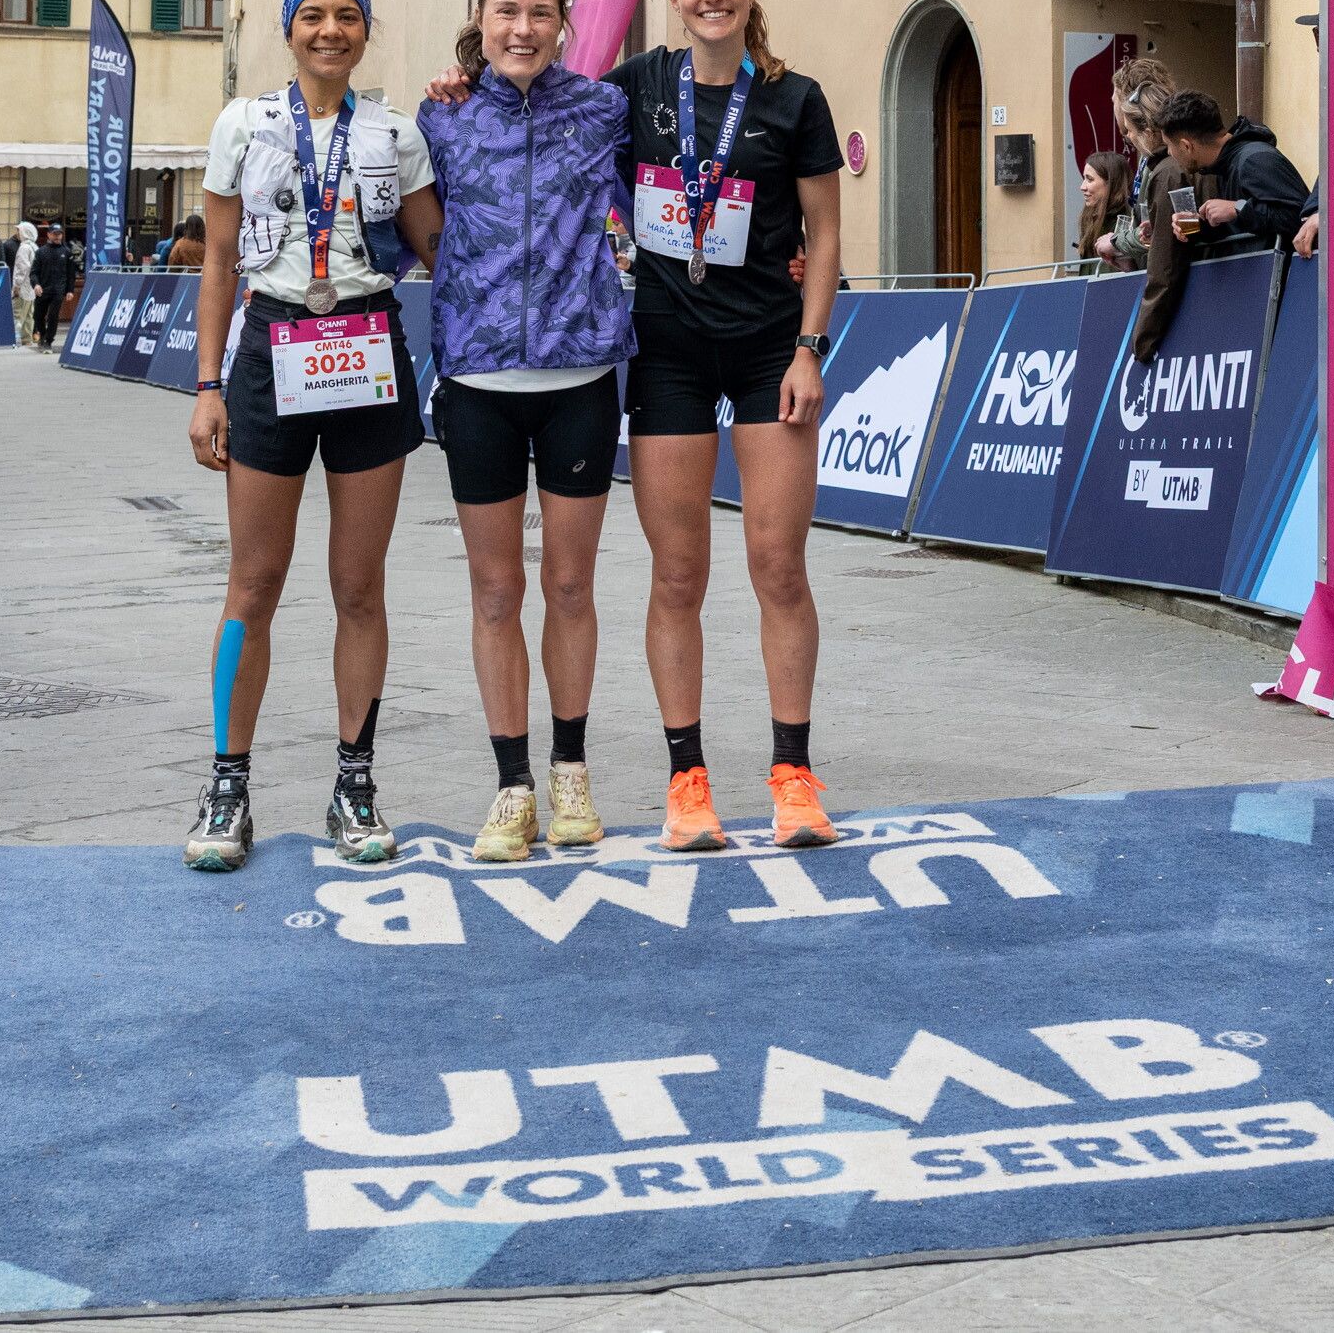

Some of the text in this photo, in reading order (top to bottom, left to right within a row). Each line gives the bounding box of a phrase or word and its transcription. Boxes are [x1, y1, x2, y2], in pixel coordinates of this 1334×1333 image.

[717, 106, 739, 156] FINISHER
[327, 135, 345, 182] FINISHER
[322, 188, 334, 212] CMT
[661, 203, 716, 230] 301
[167, 328, 197, 351] SUUNTO
[315, 340, 352, 352] CMT46
[304, 351, 366, 376] 3023
[305, 375, 369, 391] MARGHERITA
[1120, 350, 1252, 432] CHIANTI
[1119, 437, 1233, 450] ULTRA TRAIL
[967, 443, 993, 470] FLY
[992, 443, 1053, 475] HUMAN
[1133, 469, 1201, 502] BY UTMB
[352, 1115, 1319, 1213] WORLD SERIES
